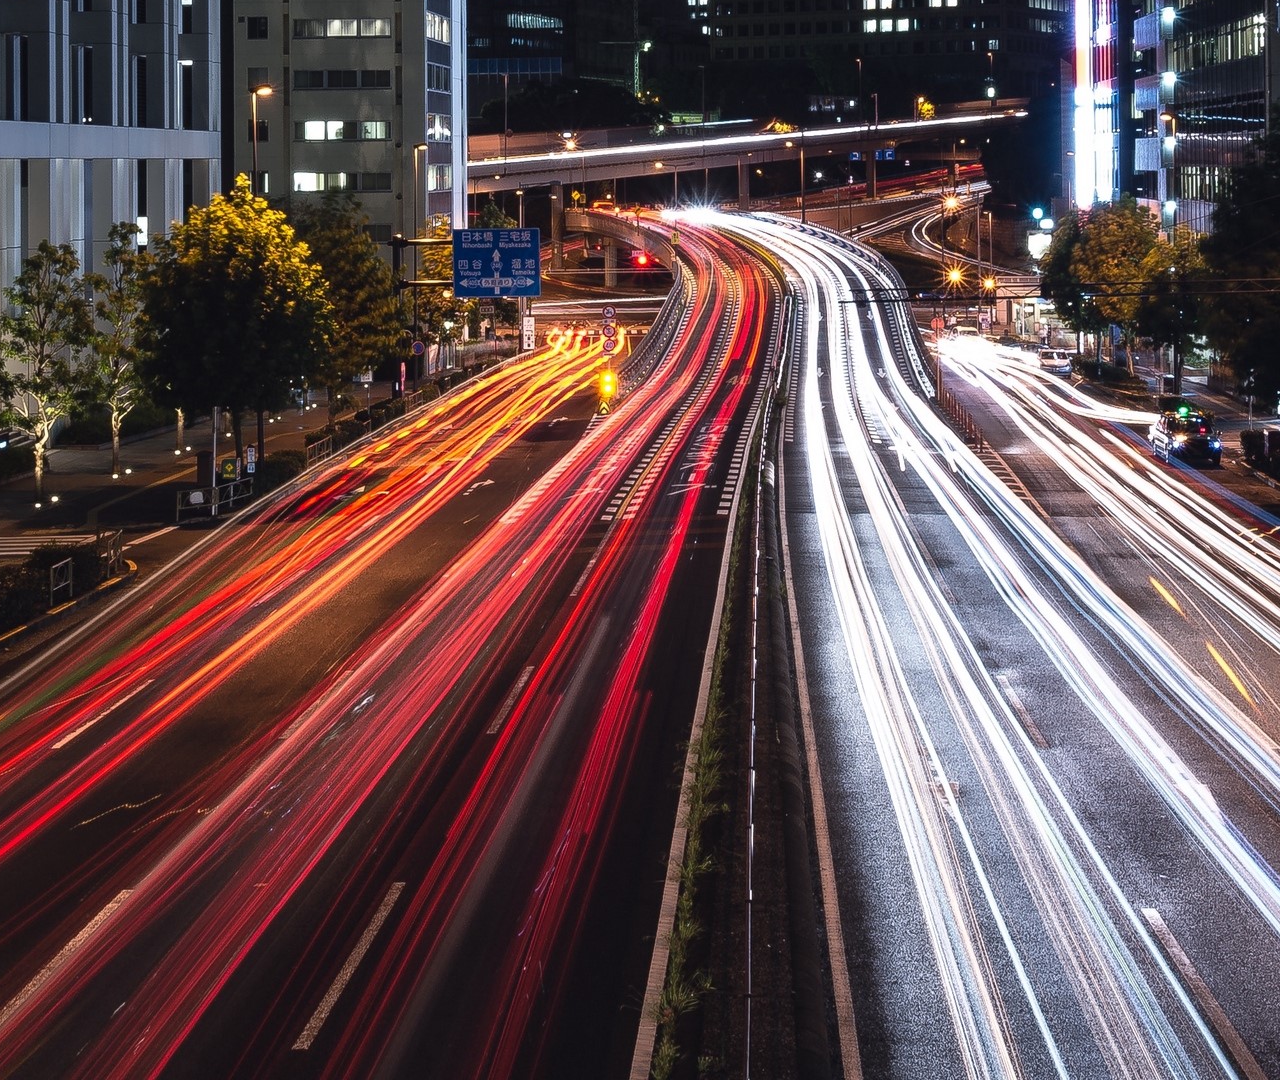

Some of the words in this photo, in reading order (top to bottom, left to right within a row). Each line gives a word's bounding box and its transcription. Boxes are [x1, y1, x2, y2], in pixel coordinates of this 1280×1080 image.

[462, 232, 493, 242] 日本橋
[499, 231, 531, 241] 三宅坂
